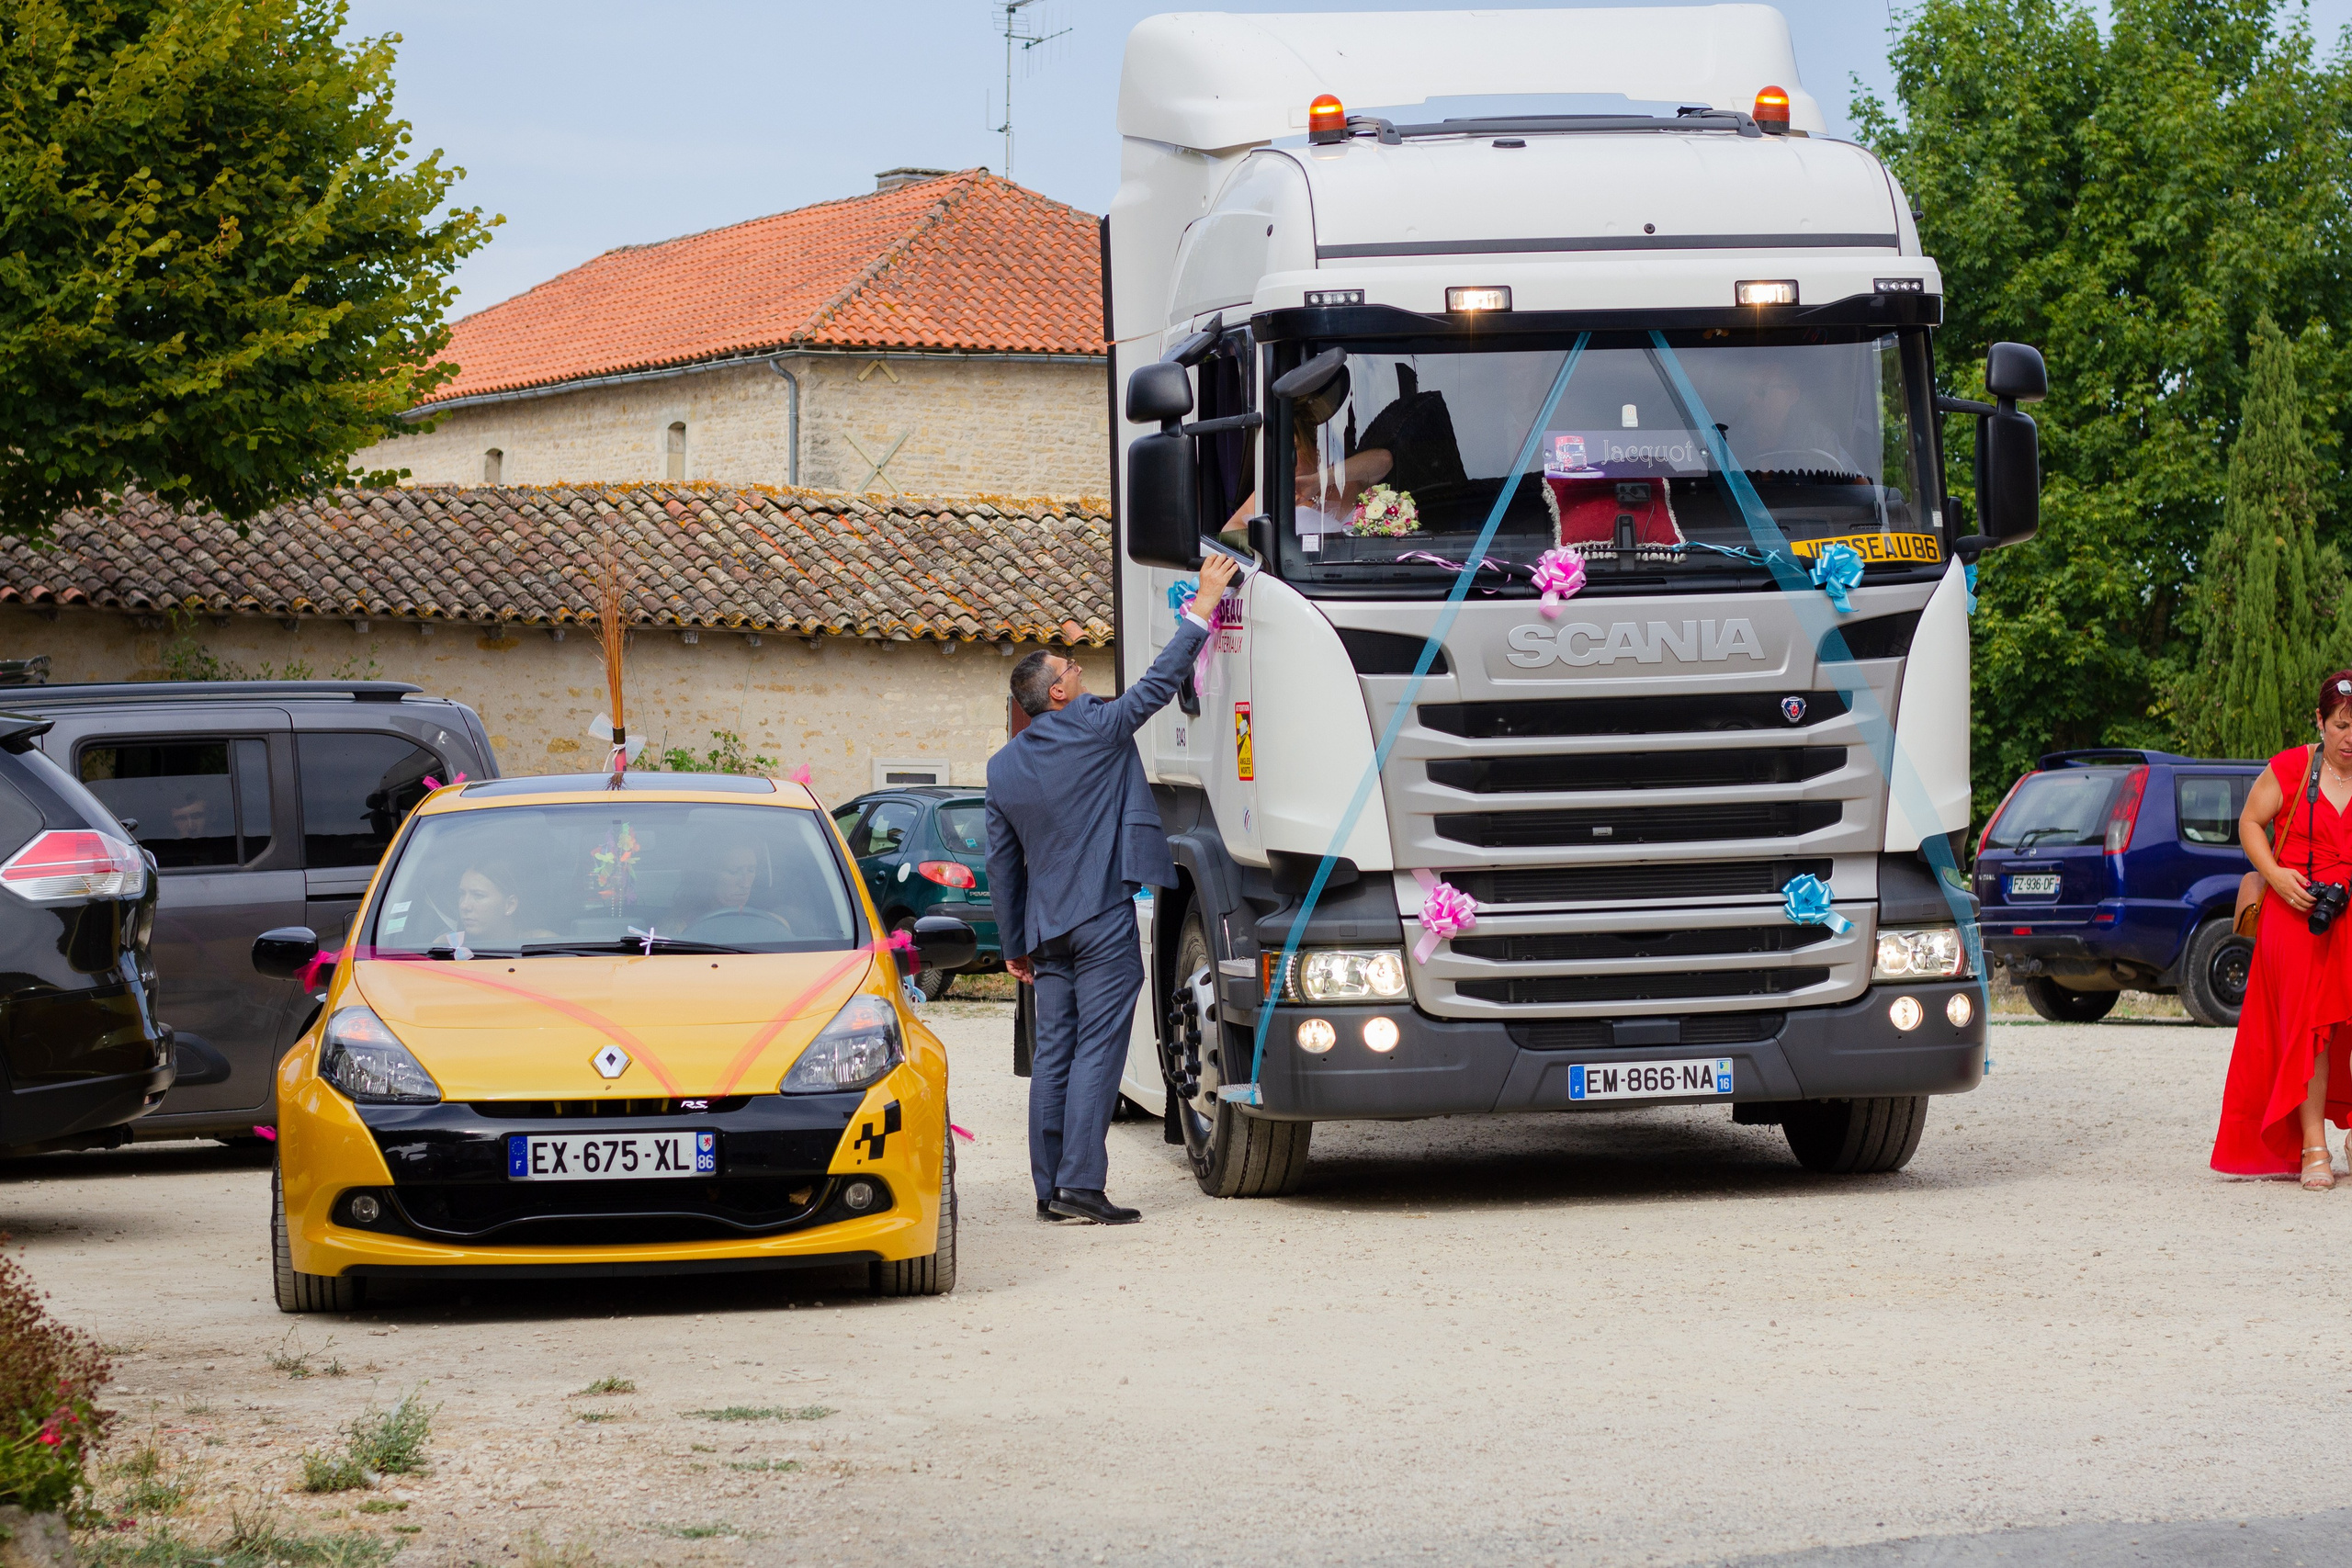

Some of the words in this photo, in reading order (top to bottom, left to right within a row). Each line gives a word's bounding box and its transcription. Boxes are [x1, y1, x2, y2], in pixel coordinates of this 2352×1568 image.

[1601, 439, 1692, 468] Jacquot
[1806, 536, 1939, 560] VSEAU86
[1219, 599, 1244, 623] DEAU
[1506, 618, 1767, 669] SCANIA
[1586, 1065, 1714, 1094] EM-866-NA
[1719, 1077, 1730, 1090] 16
[515, 1160, 522, 1169] F
[532, 1139, 690, 1174] EX-675-XL
[697, 1155, 714, 1169] 86
